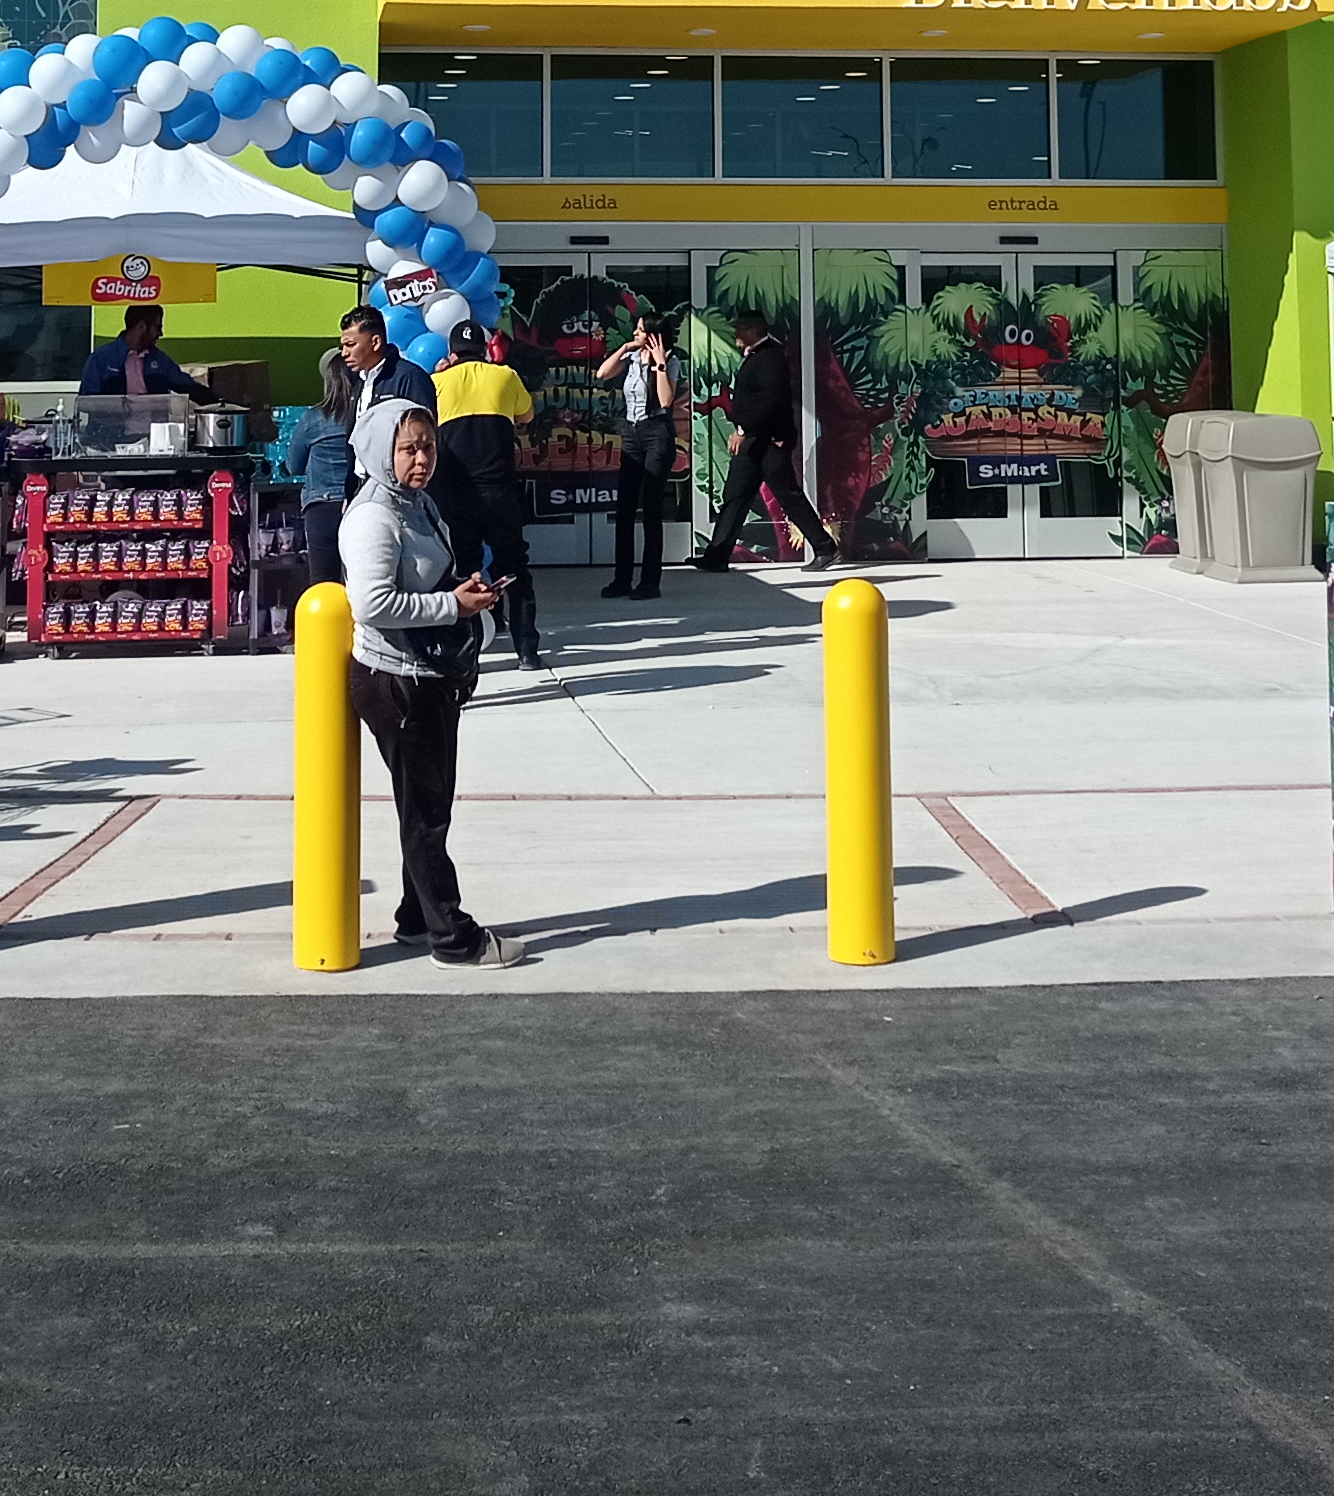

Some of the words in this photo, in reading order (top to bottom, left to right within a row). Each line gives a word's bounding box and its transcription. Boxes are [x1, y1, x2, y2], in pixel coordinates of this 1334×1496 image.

[560, 193, 618, 210] salida
[987, 195, 1059, 211] entrada
[95, 278, 157, 299] Sabritas
[388, 277, 437, 305] Doritos
[1051, 389, 1080, 410] DE
